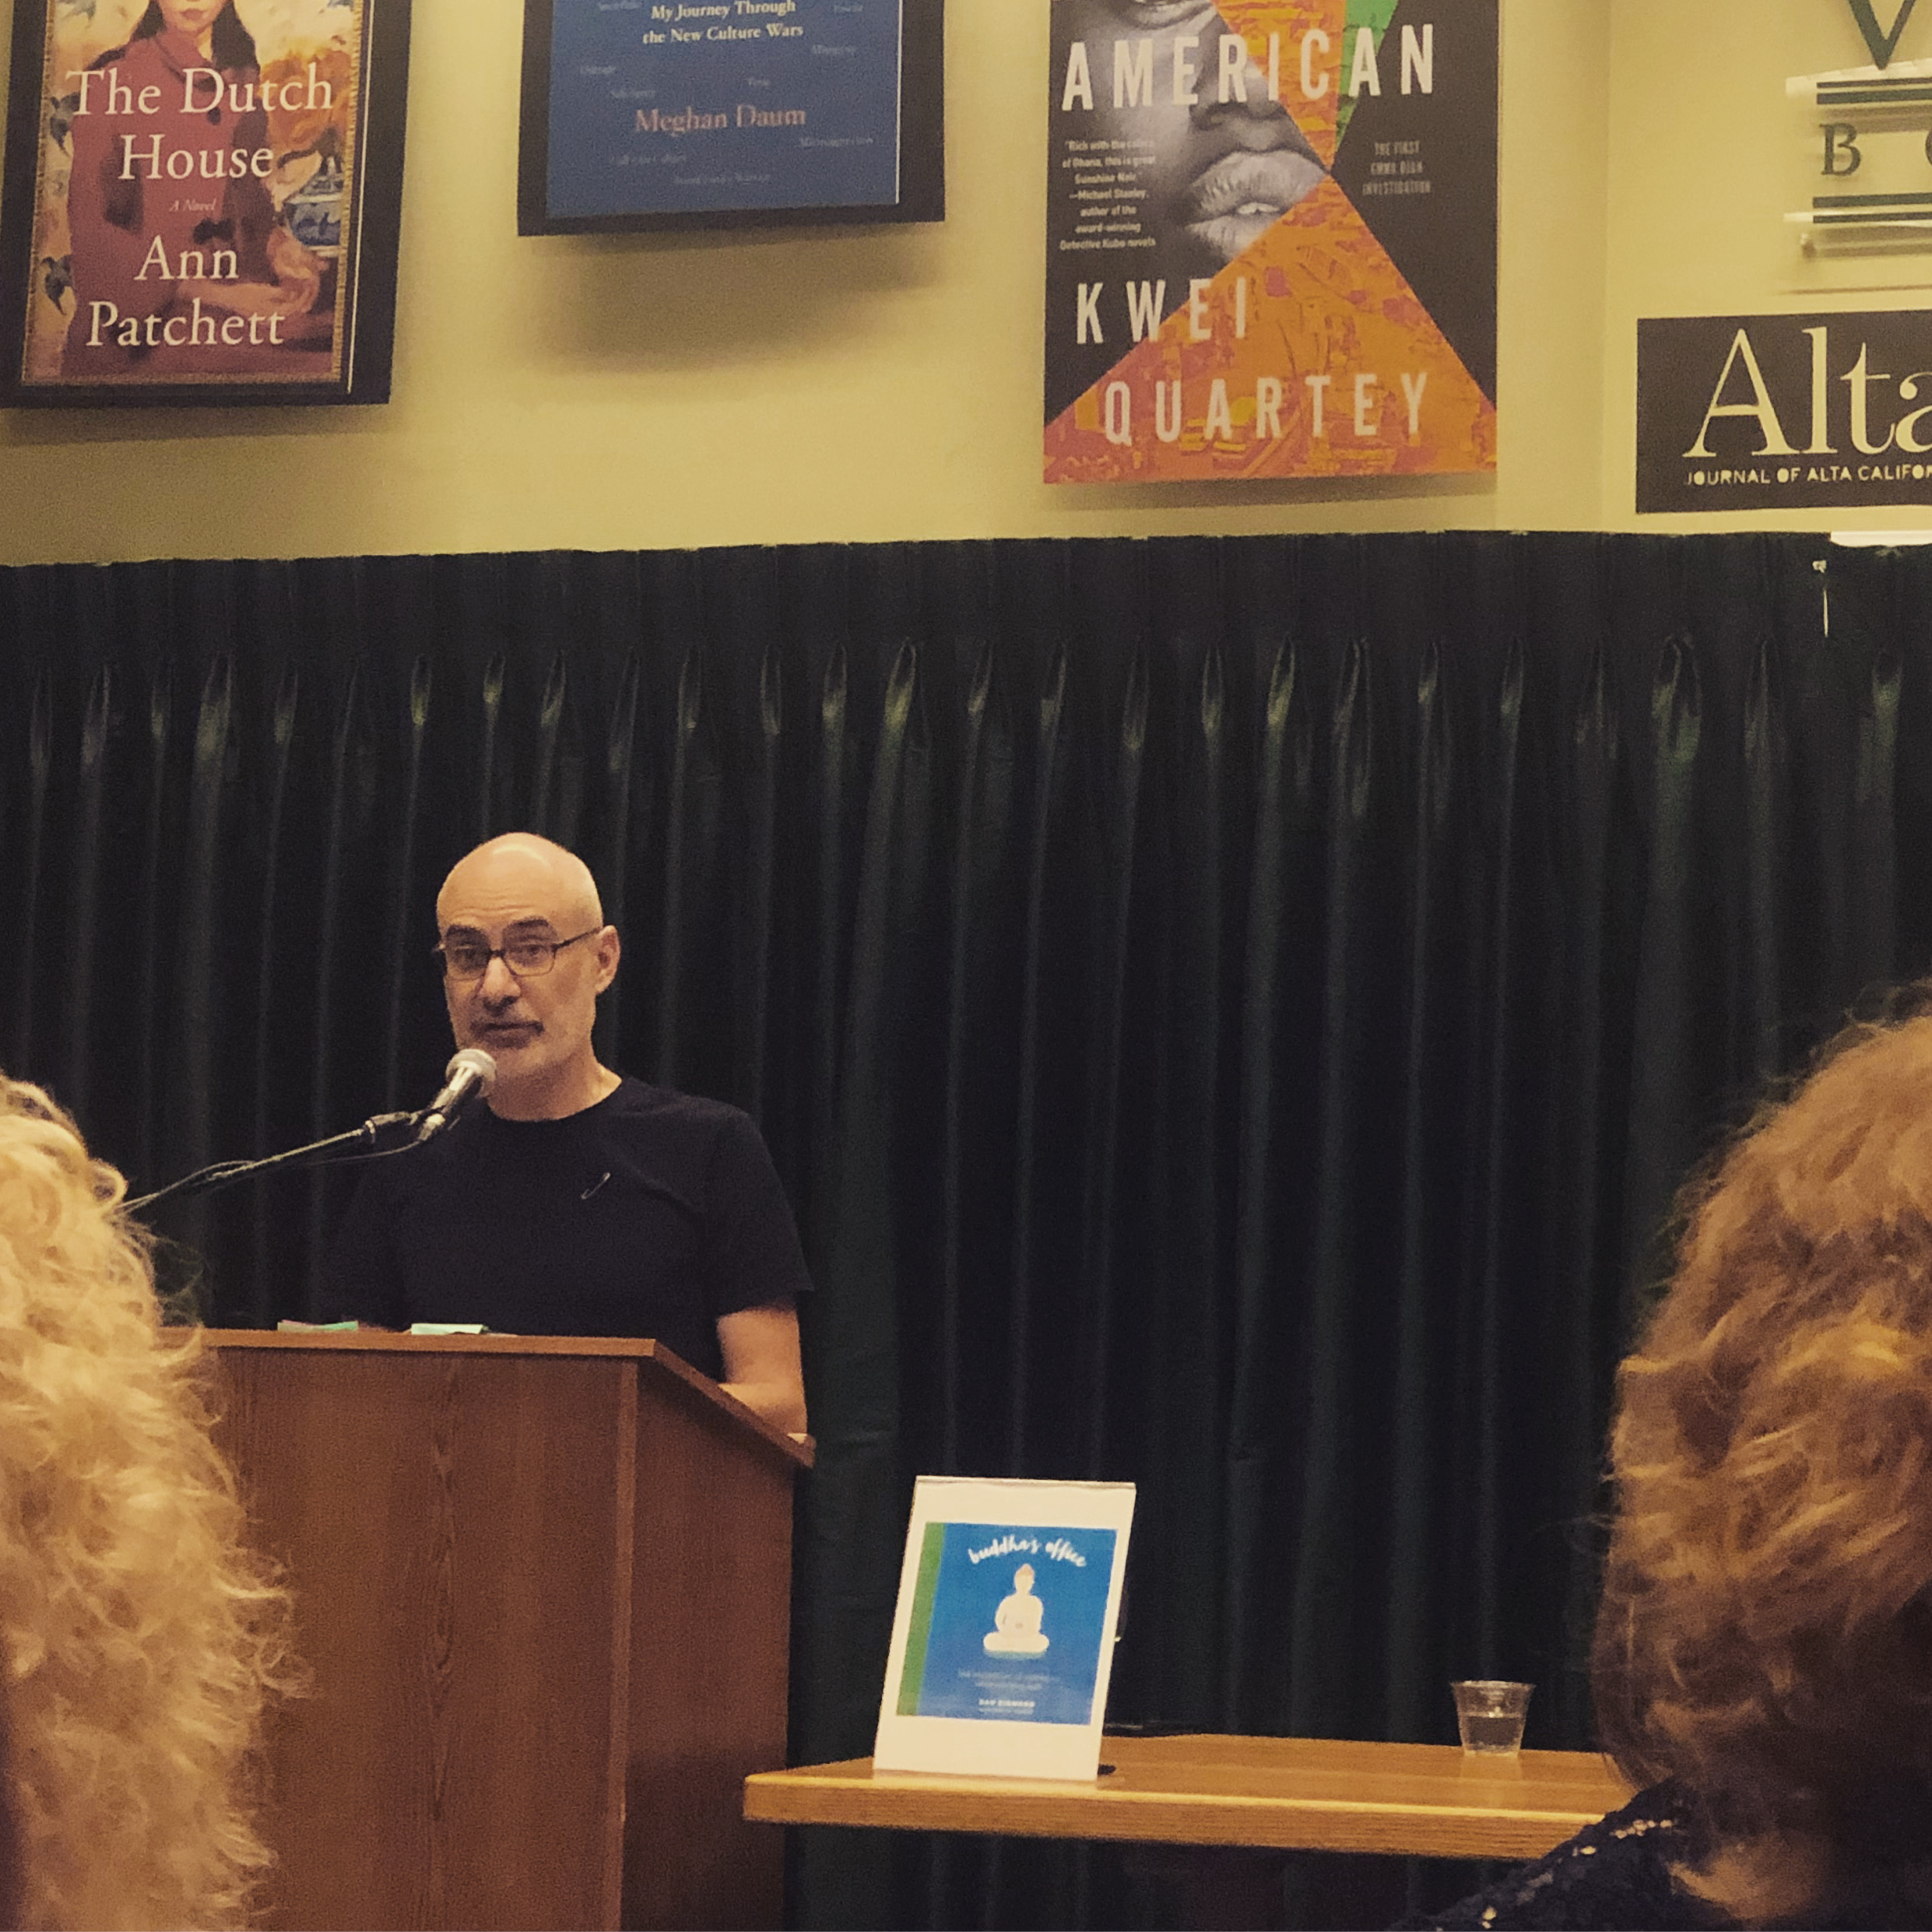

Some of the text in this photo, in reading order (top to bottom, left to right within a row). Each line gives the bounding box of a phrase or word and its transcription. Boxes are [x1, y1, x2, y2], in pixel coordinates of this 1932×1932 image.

[642, 23, 804, 44] the New Culture Wars
[652, 5, 673, 23] My
[675, 3, 730, 22] Journey
[735, 0, 796, 16] Through
[65, 61, 333, 117] The Dutch
[1062, 23, 1434, 111] AMERICAN
[634, 104, 806, 138] Meghan Daum
[118, 133, 274, 180] House
[1062, 158, 1071, 168] of
[168, 198, 217, 212] A Novel
[1080, 205, 1136, 217] author of the
[134, 235, 239, 280] Ann
[85, 298, 285, 347] Patchett
[1077, 277, 1245, 344] KWEI
[1105, 372, 1427, 446] QUARTEY
[1682, 326, 1932, 457] Alta
[1687, 469, 1771, 486] JOURNAL
[1776, 468, 1800, 483] OF
[1807, 465, 1853, 483] ALTA
